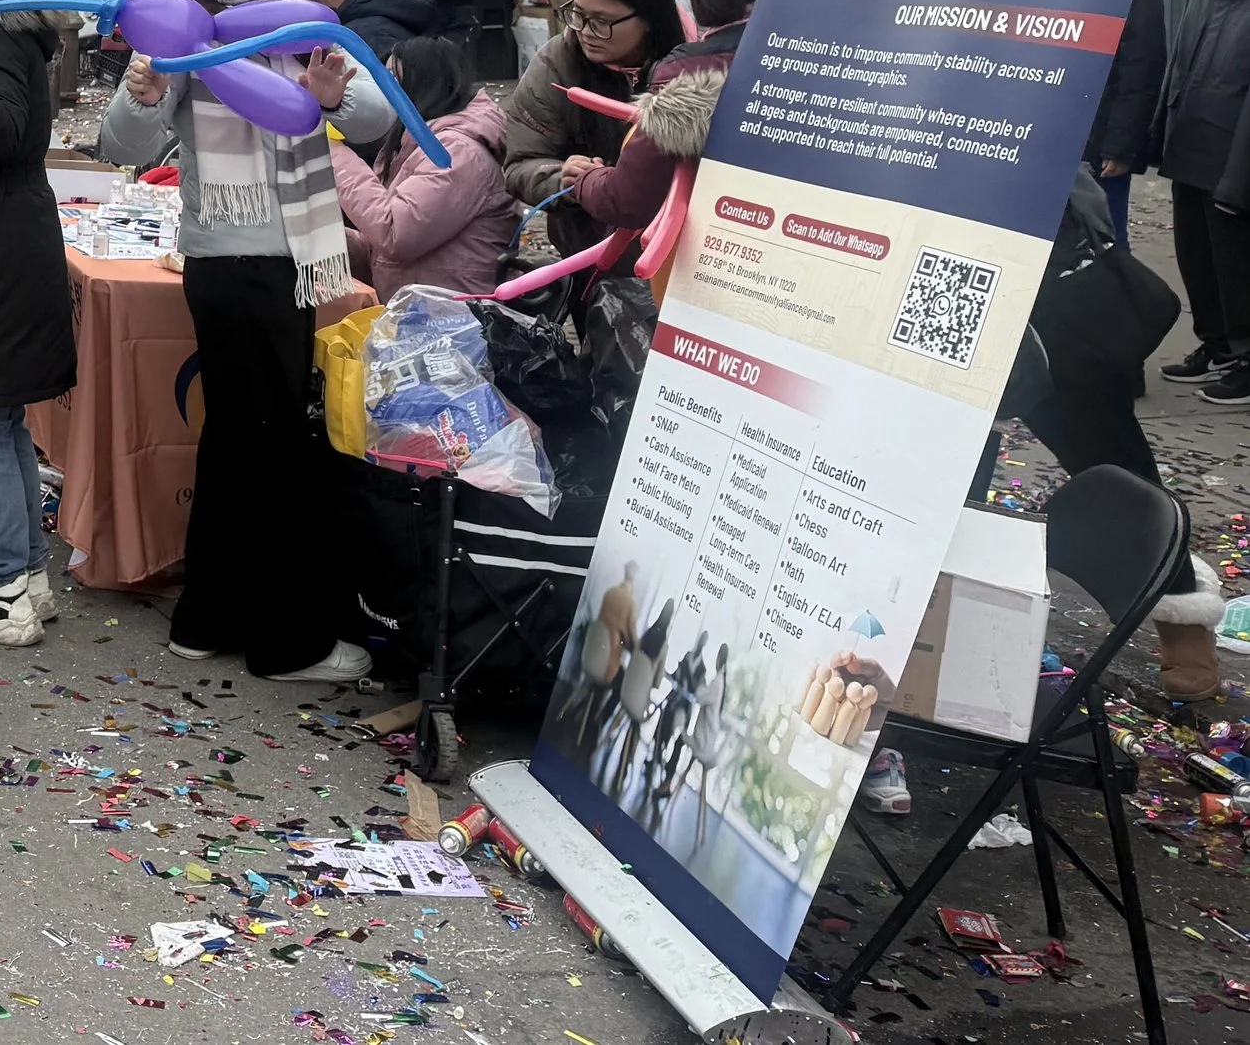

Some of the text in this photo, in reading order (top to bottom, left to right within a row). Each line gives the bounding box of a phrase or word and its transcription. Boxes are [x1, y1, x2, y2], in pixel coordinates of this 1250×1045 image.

[895, 5, 1084, 42] OUR MISSION & VISION
[761, 55, 907, 87] age groups and demographics.
[767, 32, 1065, 85] Our mission is to improve community stability across all
[751, 79, 1033, 140] A stronger, more resilient community where people of
[740, 119, 938, 169] and supported to reach their full potential.
[746, 99, 1020, 164] all ages and backgrounds are empowered, connected,
[720, 201, 770, 226] Contact Us
[703, 235, 763, 264] 929.677.9352
[786, 218, 884, 259] Scan to Add Our Whatsapp
[699, 253, 713, 267] 827
[726, 262, 736, 274] St
[736, 266, 767, 285] Brooklyn,
[767, 275, 780, 287] NY
[779, 279, 797, 293] 11220
[693, 270, 836, 325] asianamericancommunityalliance@gmail.com
[673, 335, 761, 386] WHAT WE DO
[657, 385, 723, 424] Public Benefits
[655, 415, 679, 435] SNAP
[741, 421, 801, 462] Health Insurance
[643, 456, 701, 496] Half Fare Metro
[649, 436, 712, 476] Cash Assistance
[735, 454, 767, 480] Medicaid
[811, 455, 867, 492] Education
[636, 477, 693, 520] Public Housing
[730, 471, 768, 502] Application
[624, 519, 638, 537] Etc.
[630, 498, 694, 543] Burial Assistance
[715, 516, 747, 543] Managed
[723, 493, 782, 536] Medicaid Renewal
[799, 513, 828, 539] Chess
[806, 490, 884, 536] Arts and Craft
[709, 533, 761, 574] Long-term Care
[784, 561, 805, 584] Math
[791, 537, 848, 577] Balloon Art
[696, 573, 726, 601] Renewal
[702, 556, 757, 600] Health Insurance
[689, 594, 701, 614] Etc.
[777, 584, 809, 615] English
[818, 607, 843, 632] ELA
[763, 632, 778, 654] Etc.
[770, 609, 803, 640] Chinese
